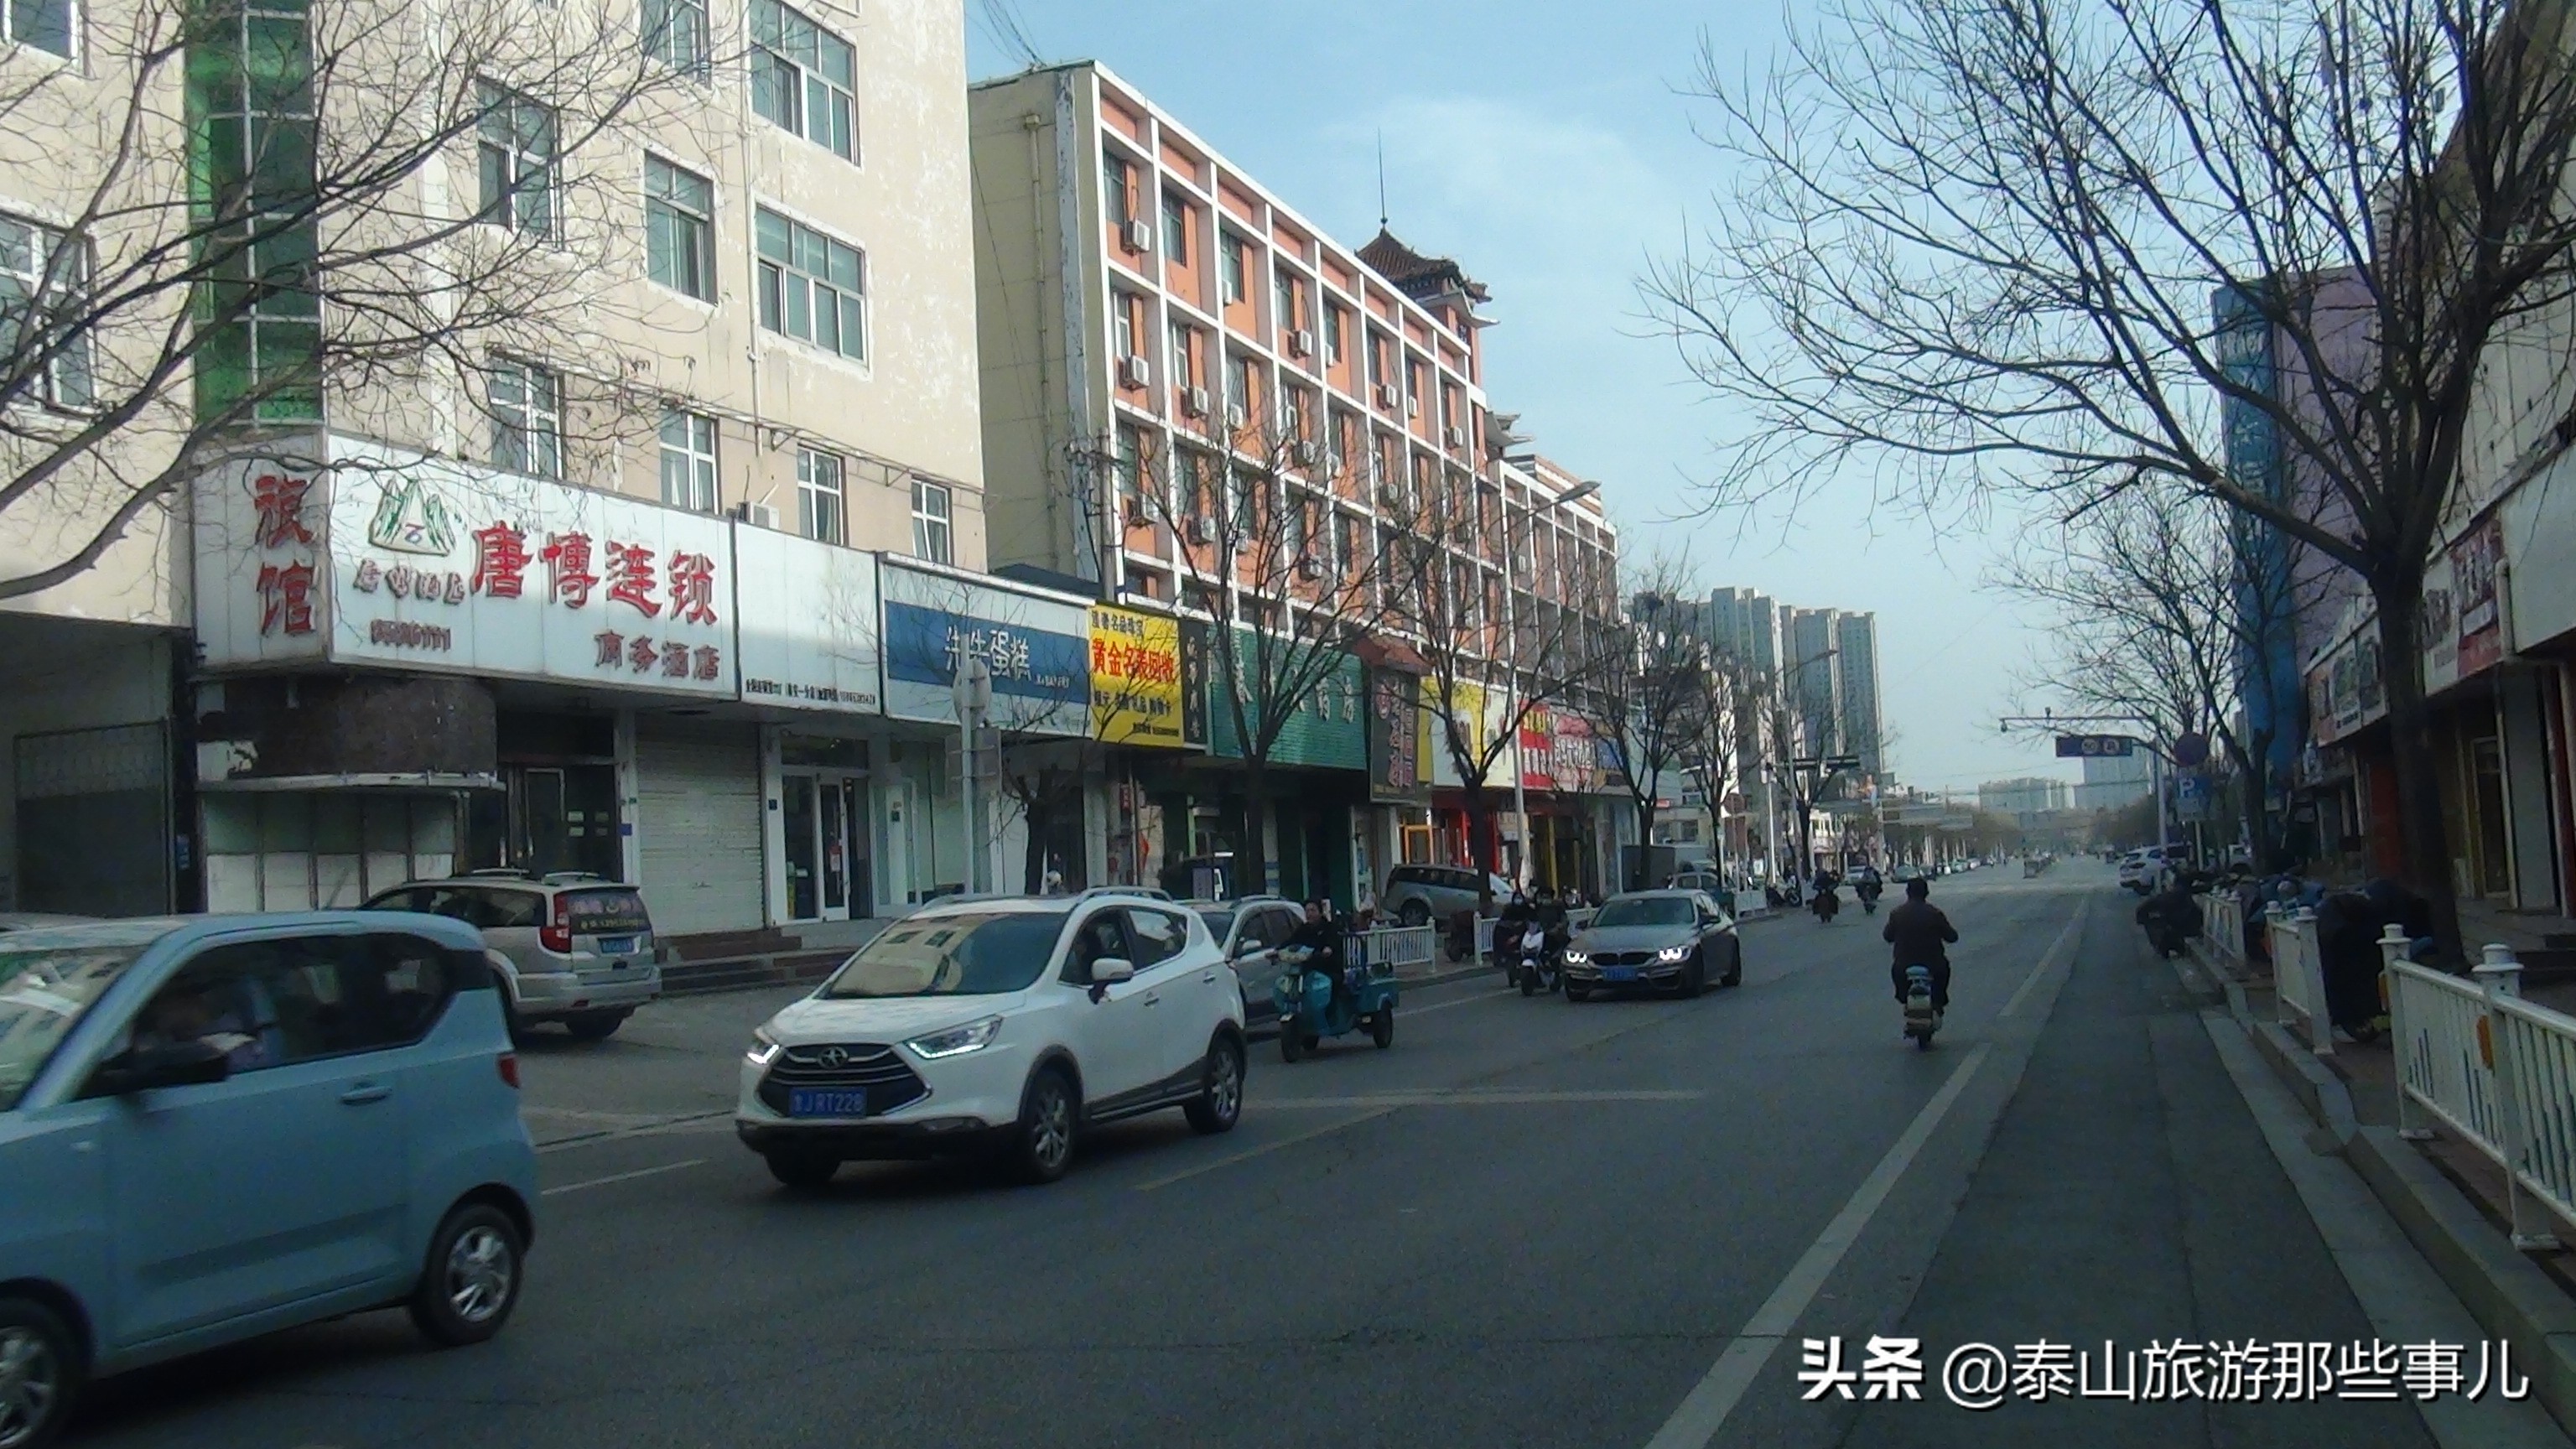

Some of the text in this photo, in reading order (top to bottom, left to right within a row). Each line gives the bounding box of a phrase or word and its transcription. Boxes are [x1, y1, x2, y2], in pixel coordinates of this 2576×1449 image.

[254, 475, 315, 636] 旅馆
[470, 518, 717, 626] 唐博连锁
[594, 629, 720, 681] 商务酒店
